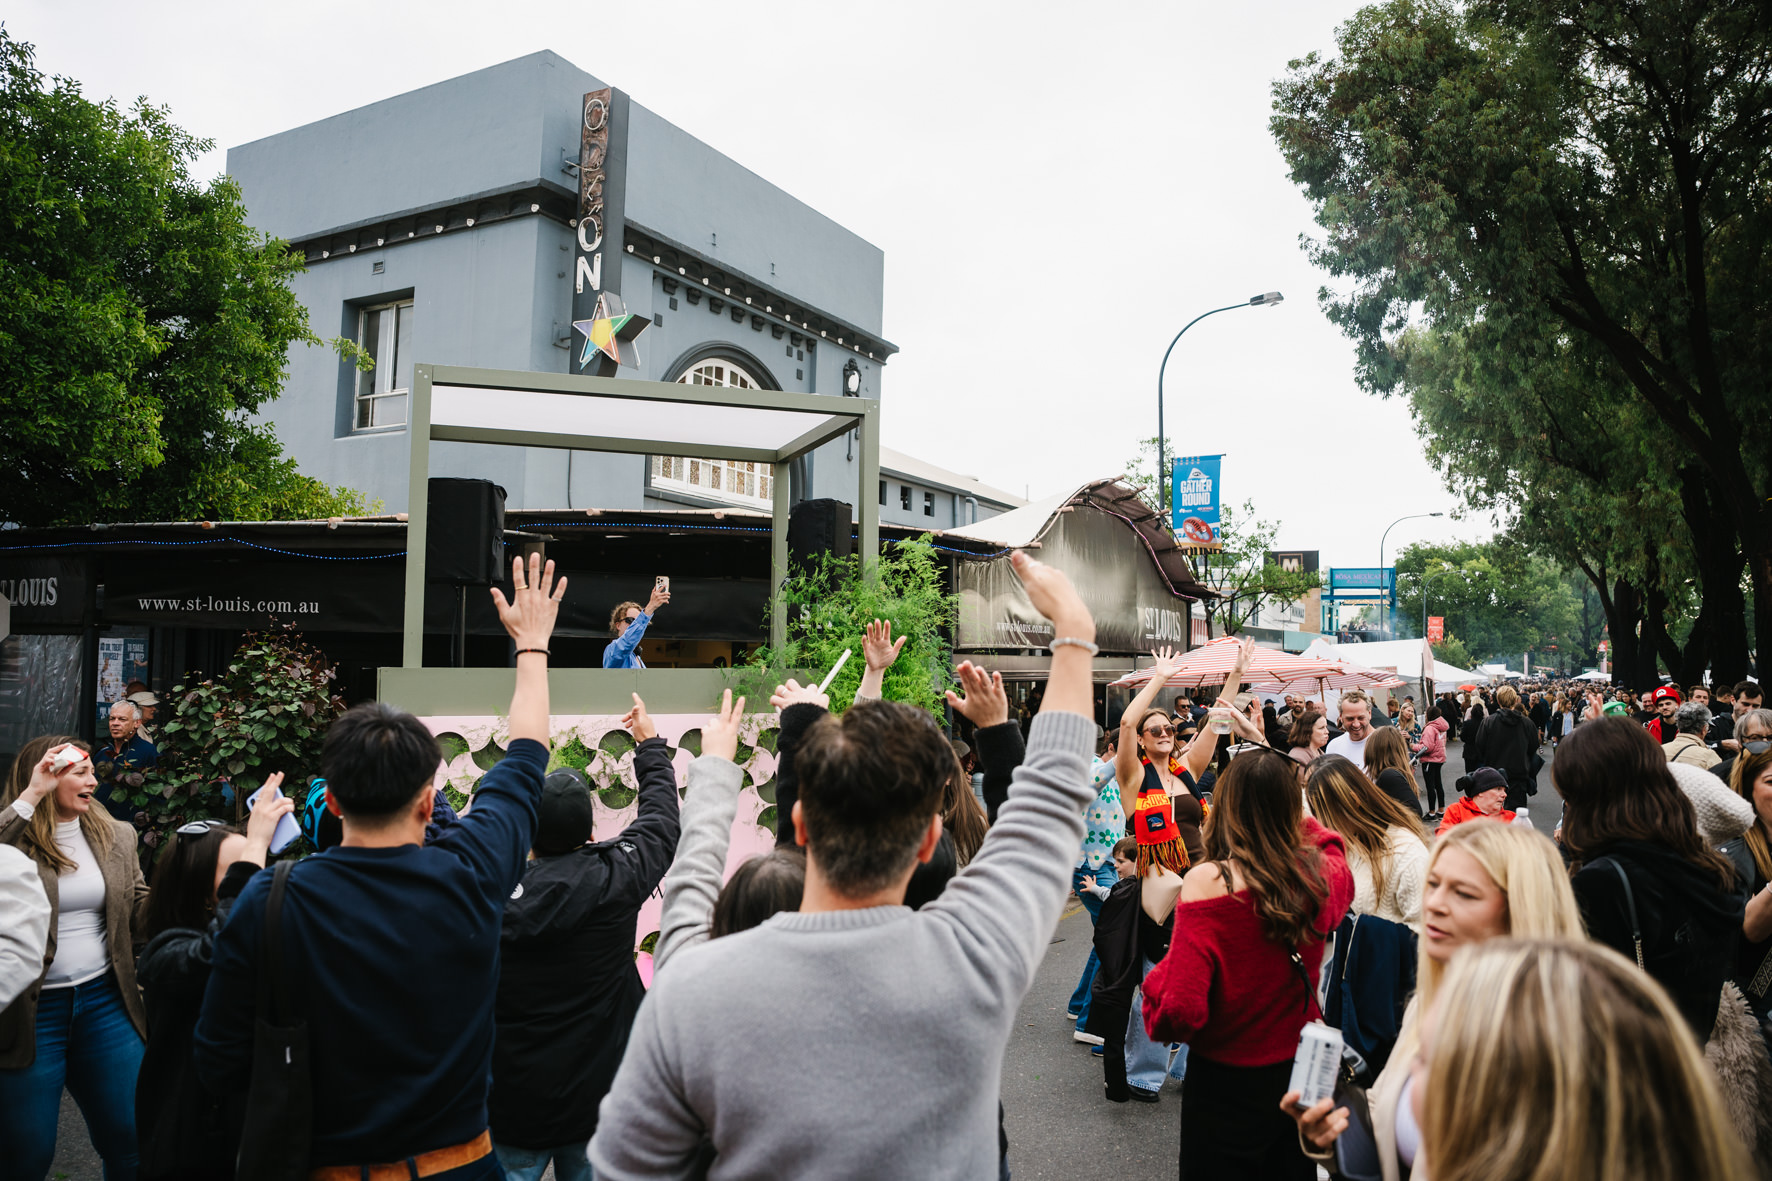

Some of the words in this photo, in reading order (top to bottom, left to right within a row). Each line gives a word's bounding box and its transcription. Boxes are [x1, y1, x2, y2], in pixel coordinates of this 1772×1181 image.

[1181, 479, 1212, 493] GATHER
[1182, 492, 1210, 506] ROUND
[9, 577, 58, 606] LOUIS
[138, 596, 320, 614] www.st-louis.com.au
[1155, 608, 1181, 642] LOUIS
